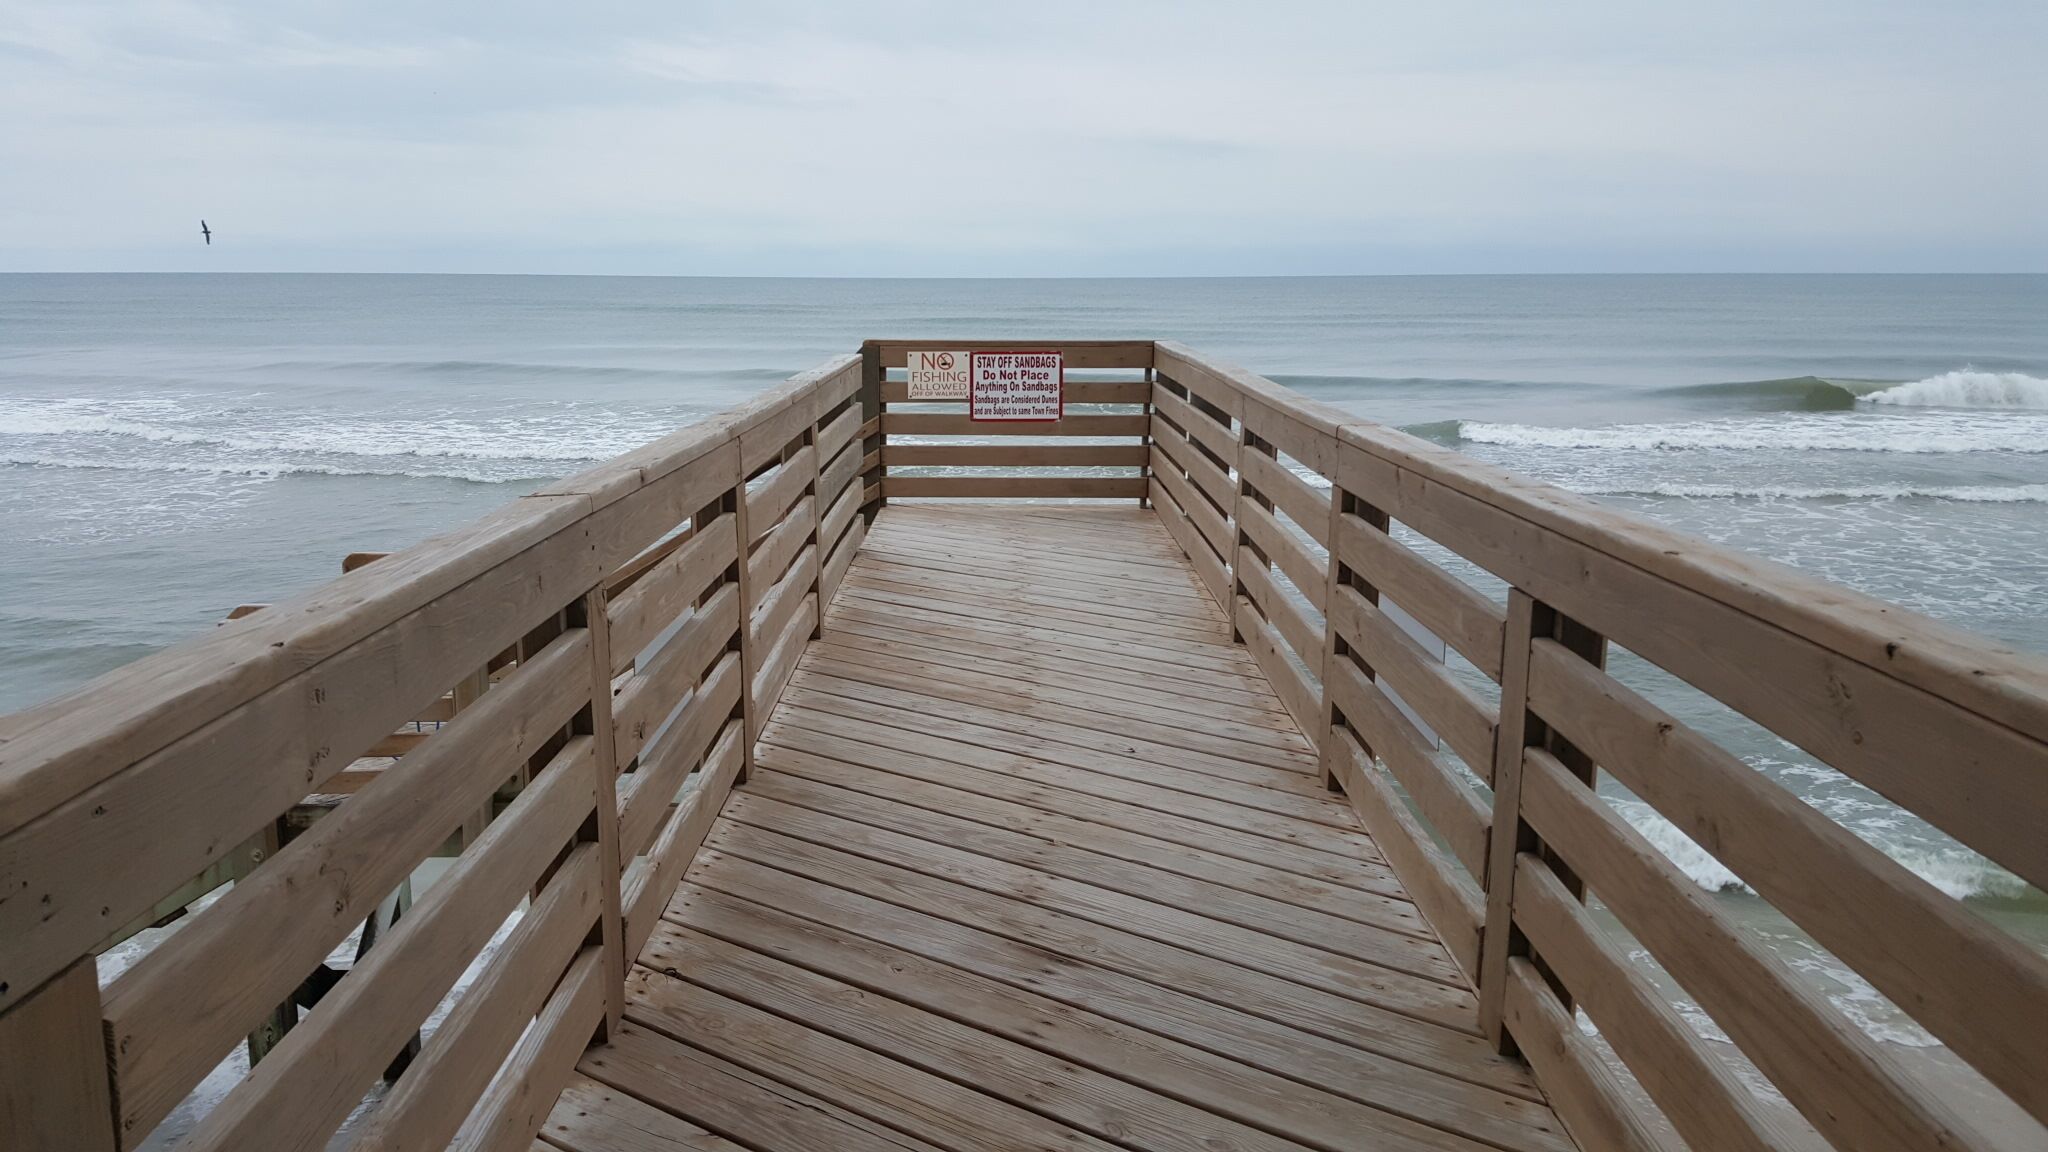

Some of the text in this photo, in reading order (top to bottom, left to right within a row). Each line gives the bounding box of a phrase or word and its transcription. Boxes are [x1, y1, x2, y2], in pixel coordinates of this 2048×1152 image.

[977, 356, 1056, 368] STAY OFF SANDBAGS
[912, 372, 966, 382] FISHING
[983, 370, 1049, 380] Do Not Place
[975, 382, 1058, 394] Anything On Sandbags
[975, 395, 1000, 406] Sandbags
[1011, 395, 1040, 404] Considered
[1042, 395, 1058, 404] Dunes
[993, 407, 1011, 417] Subject
[1032, 407, 1044, 415] Town
[1046, 407, 1058, 415] Fines
